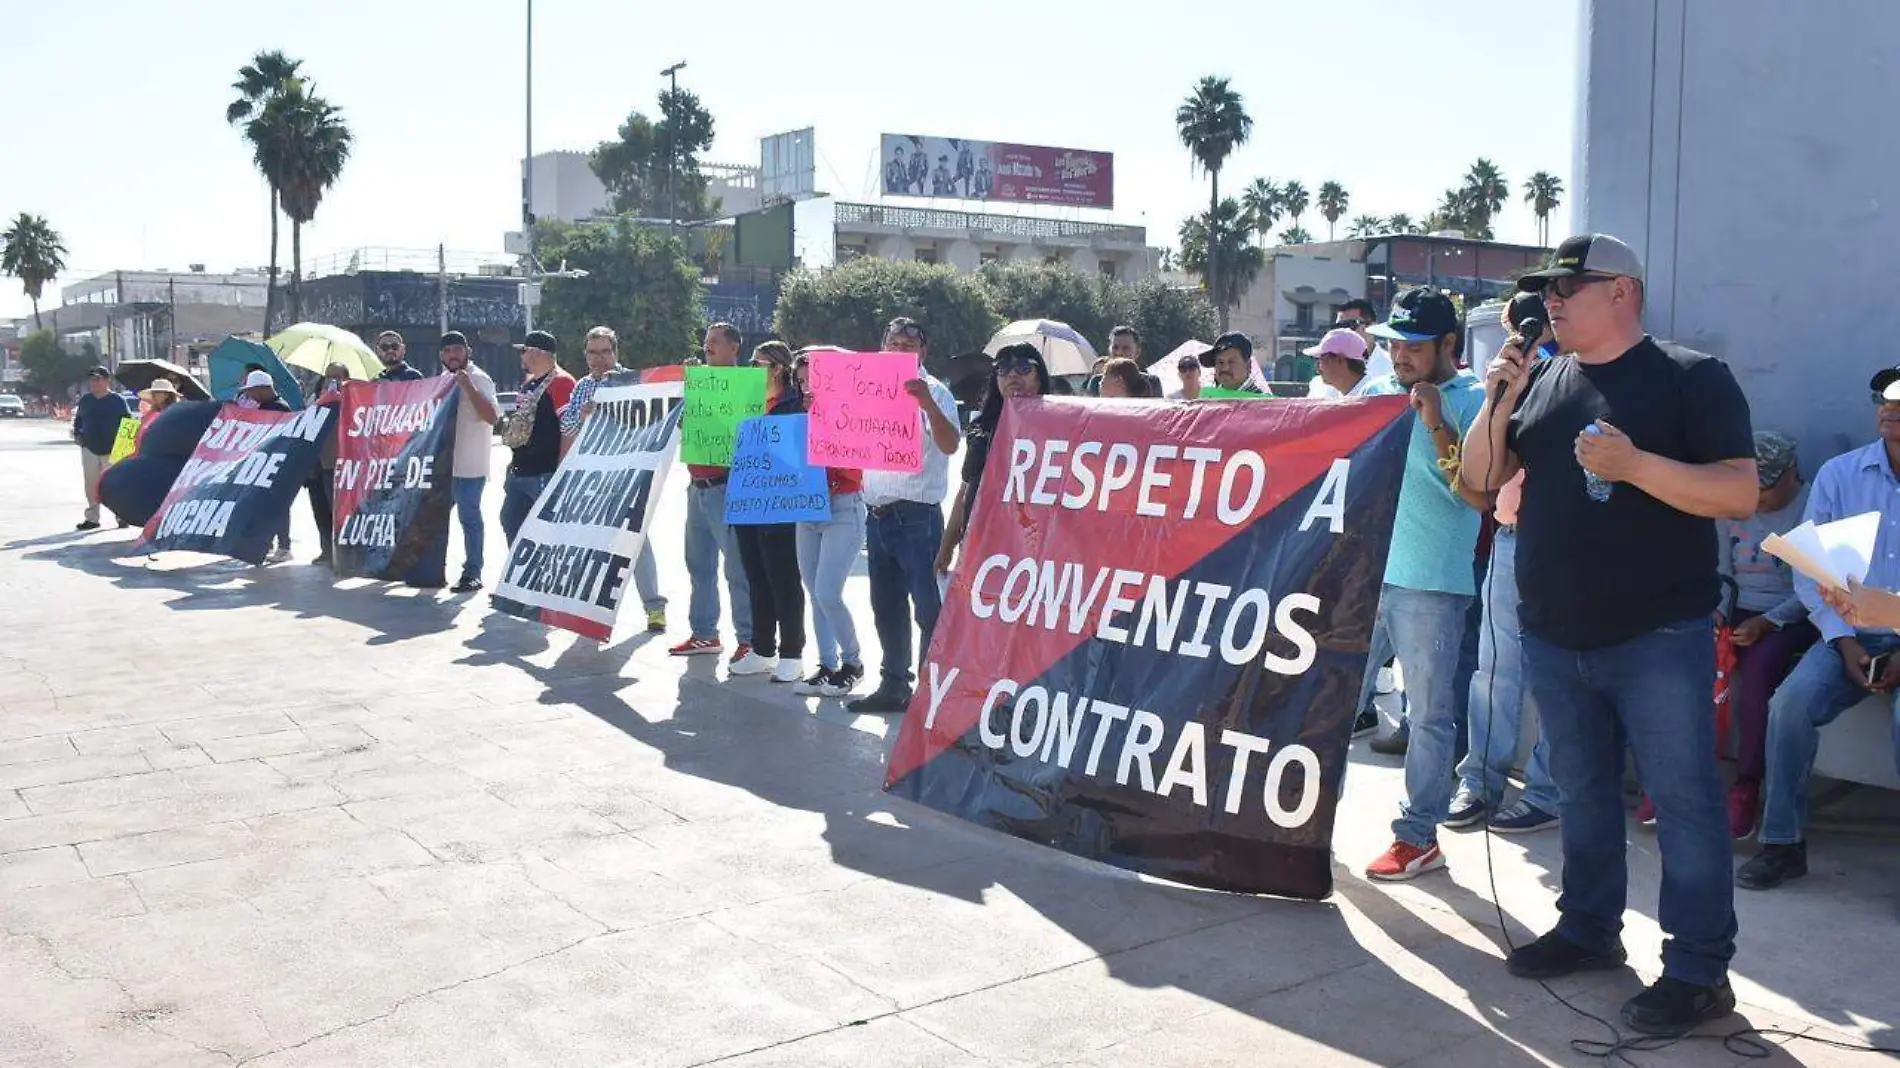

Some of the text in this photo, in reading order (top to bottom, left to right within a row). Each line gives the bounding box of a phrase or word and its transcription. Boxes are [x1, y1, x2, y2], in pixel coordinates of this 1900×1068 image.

[846, 363, 899, 400] TOCAN
[748, 417, 781, 444] MAS
[233, 452, 287, 488] DE
[333, 455, 434, 490] EN PIE DE
[877, 440, 918, 468] TODOS
[537, 468, 654, 533] LAGUNA
[1002, 437, 1351, 534] RESPETO A
[338, 514, 397, 546] LUCHA
[503, 537, 632, 611] PRESENTE
[970, 553, 1321, 676] CONVENIOS
[923, 661, 1321, 829] Y CONTRATO
